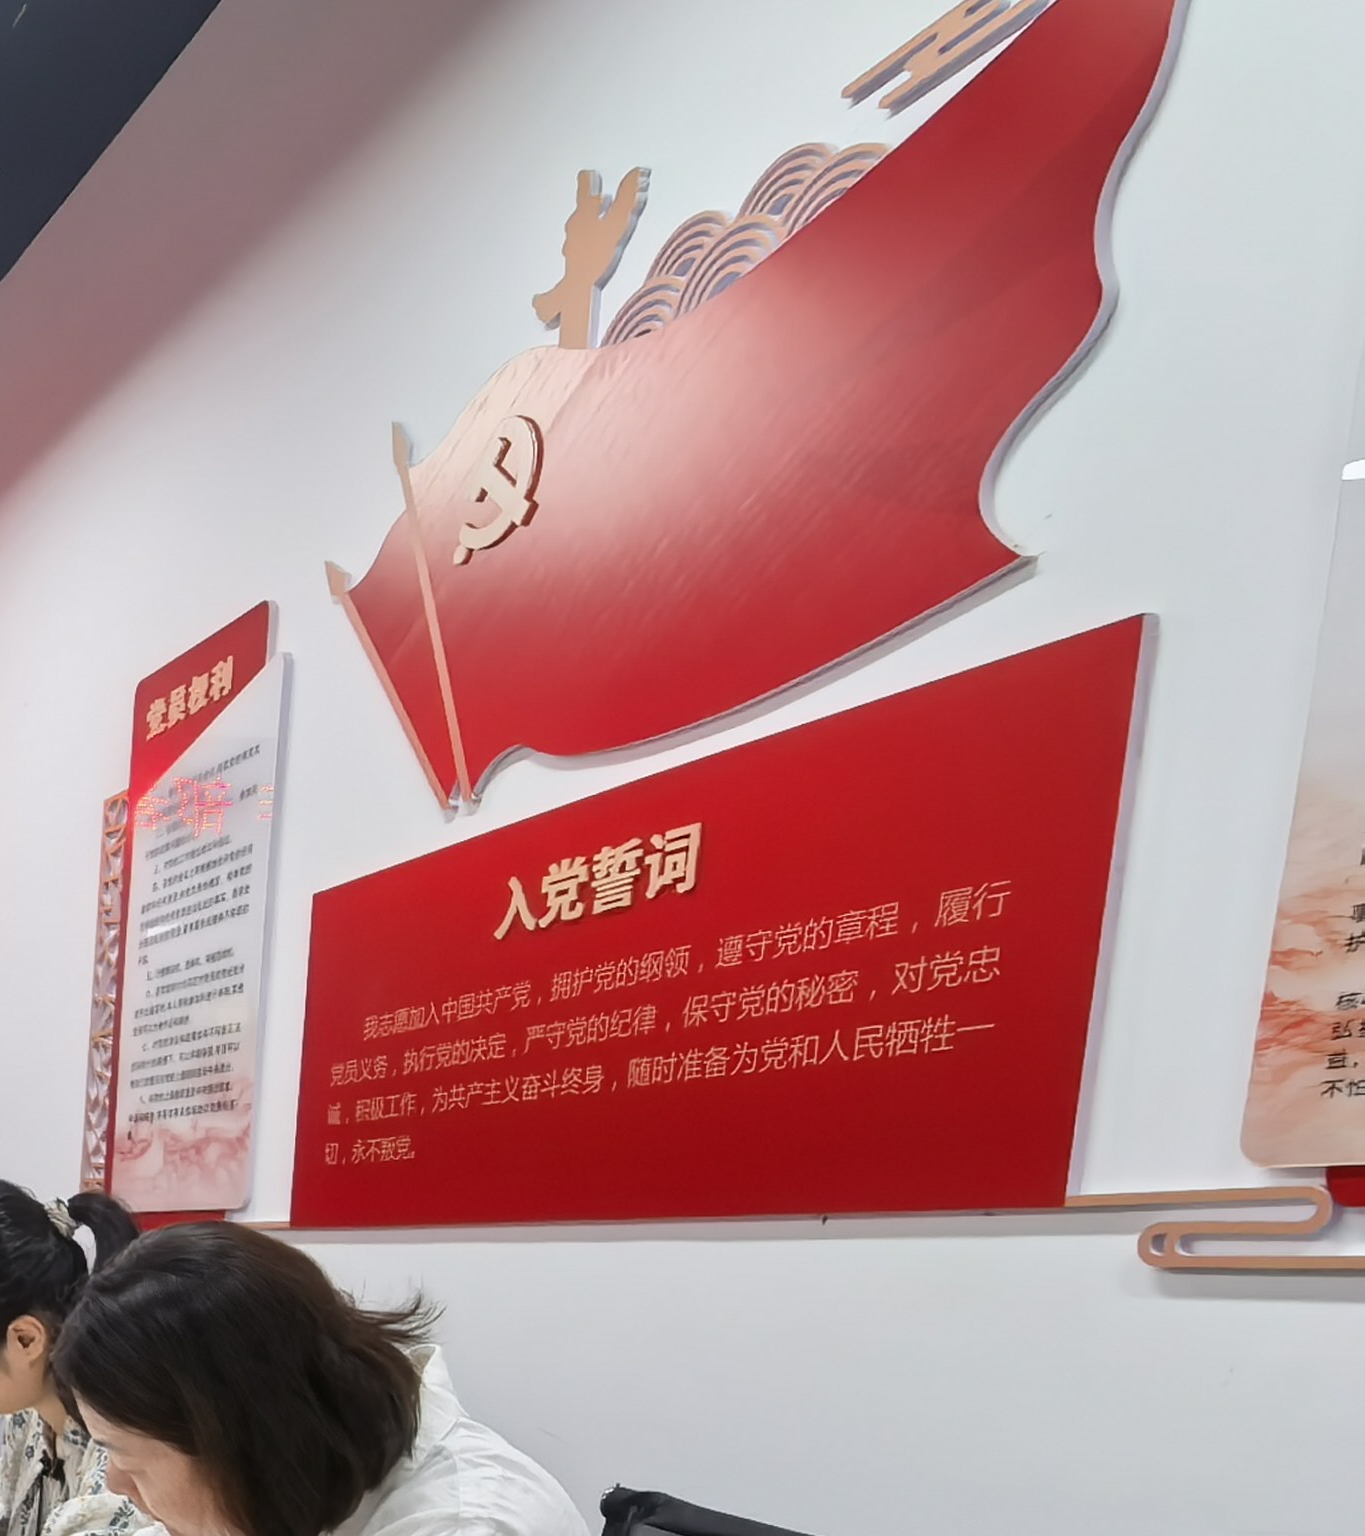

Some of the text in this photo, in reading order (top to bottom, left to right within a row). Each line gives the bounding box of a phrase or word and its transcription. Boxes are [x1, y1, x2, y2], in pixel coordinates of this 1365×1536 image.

[492, 822, 703, 941] 入党誓词
[329, 945, 1002, 1088] 党员义务，执行党的决定，严守党的纪律，保守党的秘密，对党忠
